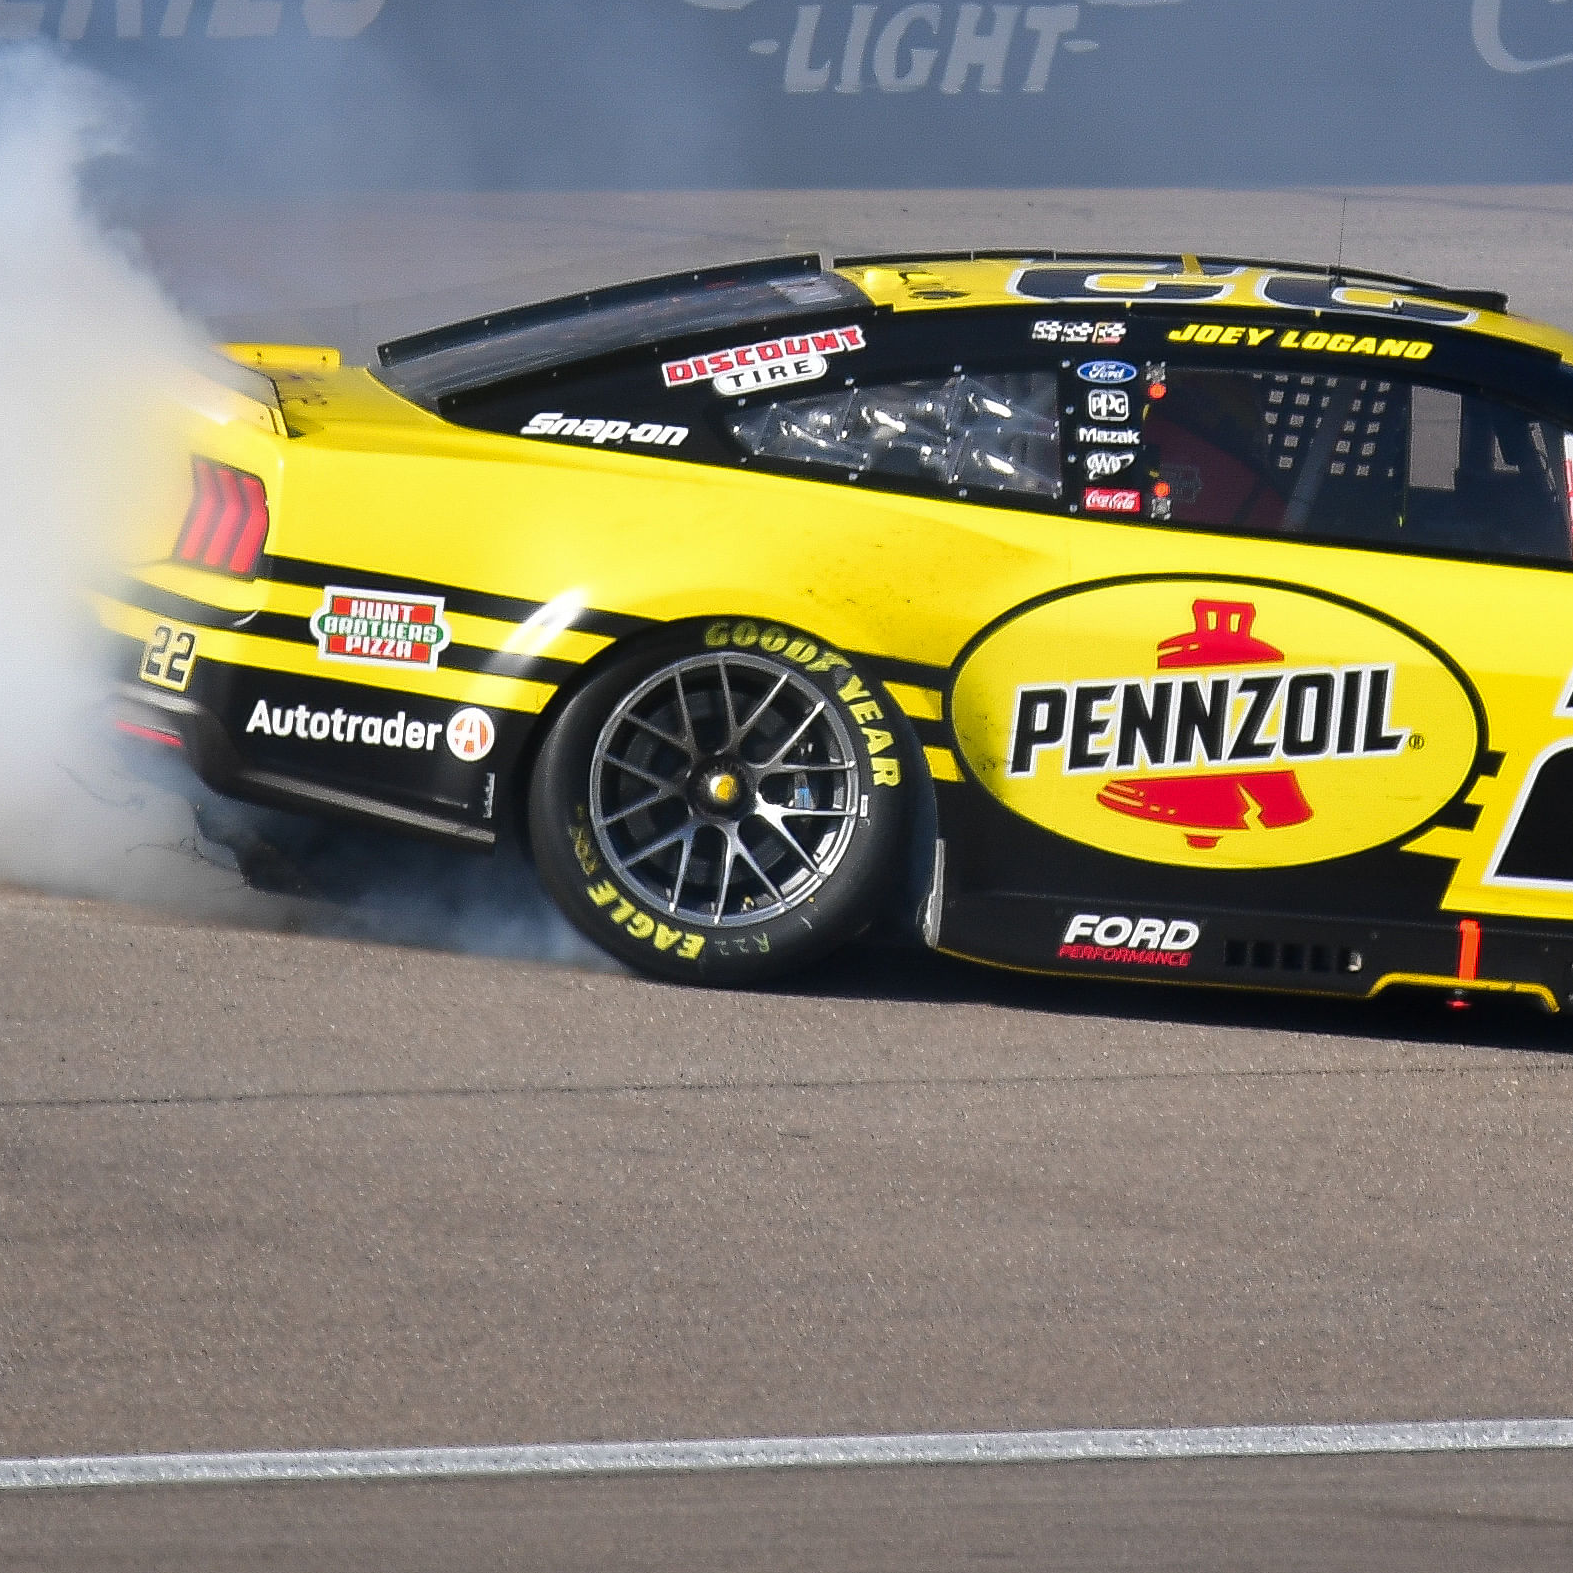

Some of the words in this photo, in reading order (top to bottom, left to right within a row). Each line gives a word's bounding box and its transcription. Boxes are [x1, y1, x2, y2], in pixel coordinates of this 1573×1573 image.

[664, 327, 864, 384] DISCOUNT
[1167, 324, 1276, 347] JOEY
[1279, 329, 1434, 360] LOGANO
[726, 358, 814, 389] TIRE
[1088, 364, 1125, 380] Ford
[1091, 394, 1126, 417] PPG
[521, 411, 690, 446] Snap-on
[1078, 427, 1141, 445] Mazak
[351, 600, 414, 623] HUNT
[323, 616, 438, 644] BROTHERS
[139, 623, 196, 692] 22
[345, 635, 413, 659] PIZZA
[245, 699, 443, 751] Autotrader
[1006, 663, 1412, 779] PENNZOIL
[587, 879, 707, 960] EAGLE
[1062, 914, 1201, 952] FORD
[1056, 944, 1191, 968] PERFORMANCE
